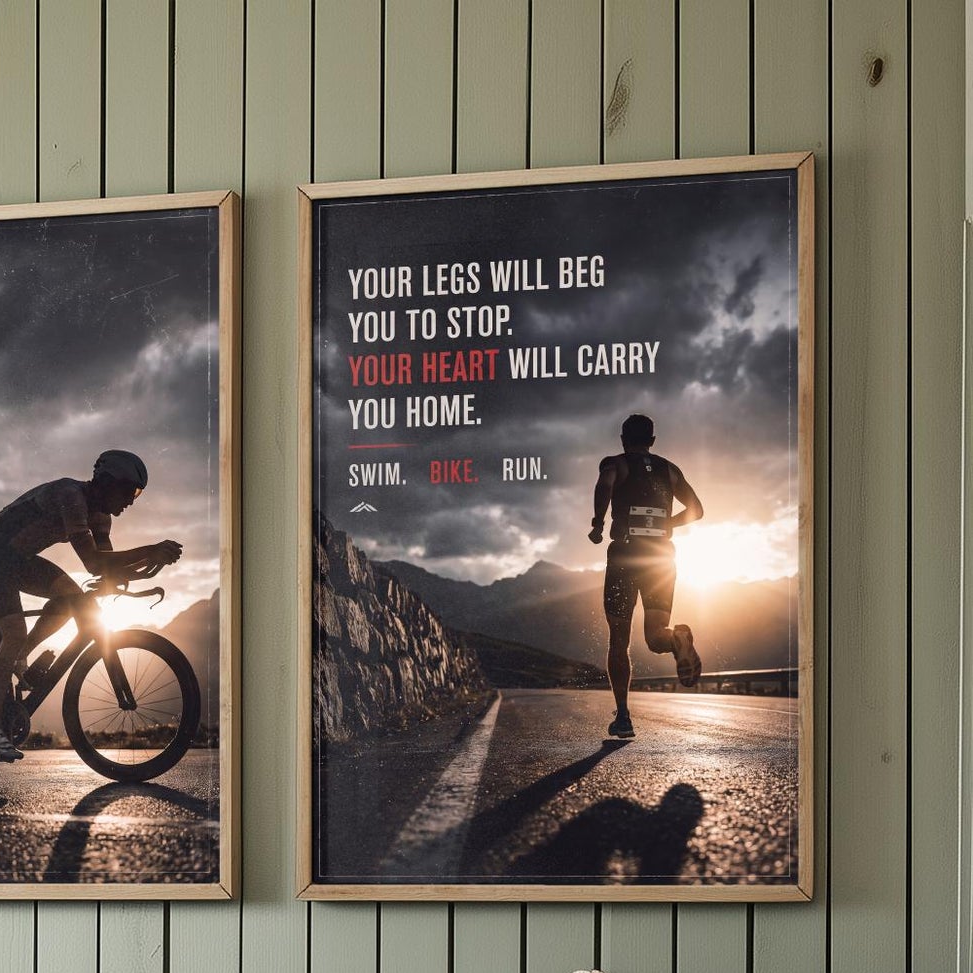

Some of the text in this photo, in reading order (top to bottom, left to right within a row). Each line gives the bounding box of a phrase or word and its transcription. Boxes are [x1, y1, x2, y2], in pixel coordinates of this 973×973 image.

[348, 254, 605, 300] YOUR LEGS WILL BEG
[348, 304, 513, 343] YOU TO STOP.
[348, 341, 661, 387] YOUR HEART WILL CARRY
[348, 393, 482, 430] YOU HOME.
[348, 456, 548, 488] SWIM. BIKE. RUN.
